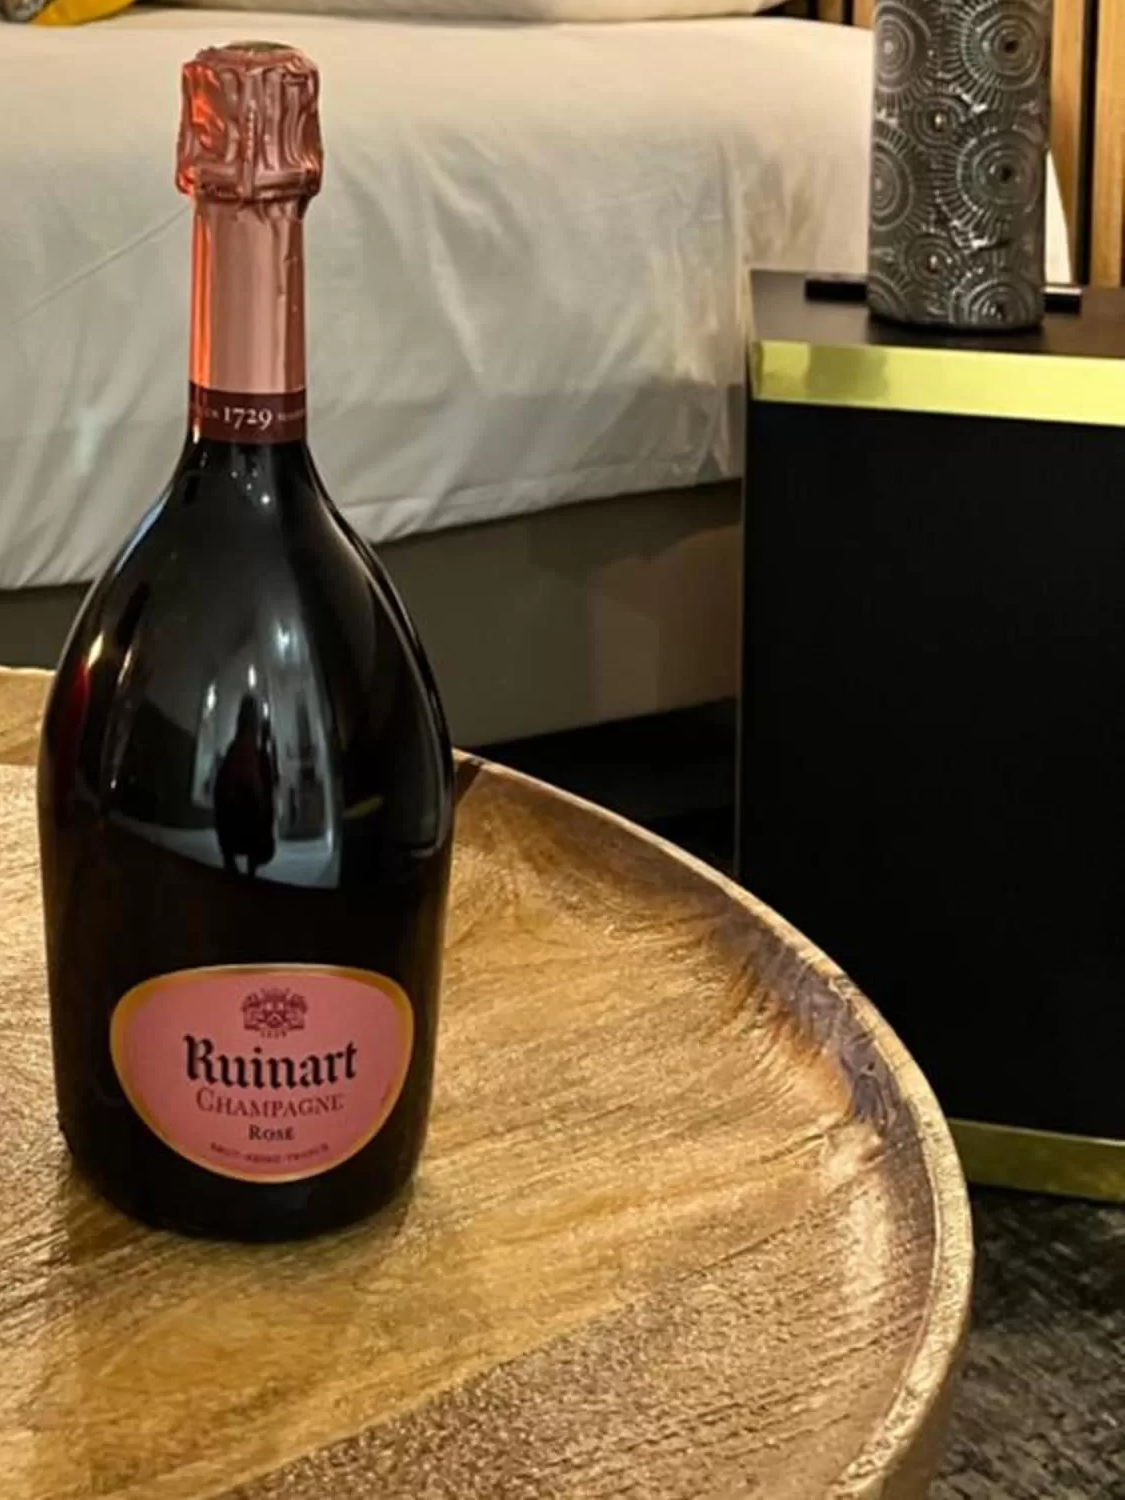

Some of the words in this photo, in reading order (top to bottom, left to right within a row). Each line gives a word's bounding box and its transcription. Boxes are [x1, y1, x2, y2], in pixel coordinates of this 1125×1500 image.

[223, 406, 273, 431] 1729
[183, 1034, 359, 1090] Ruinart
[195, 1087, 345, 1118] CHAMPAGNE
